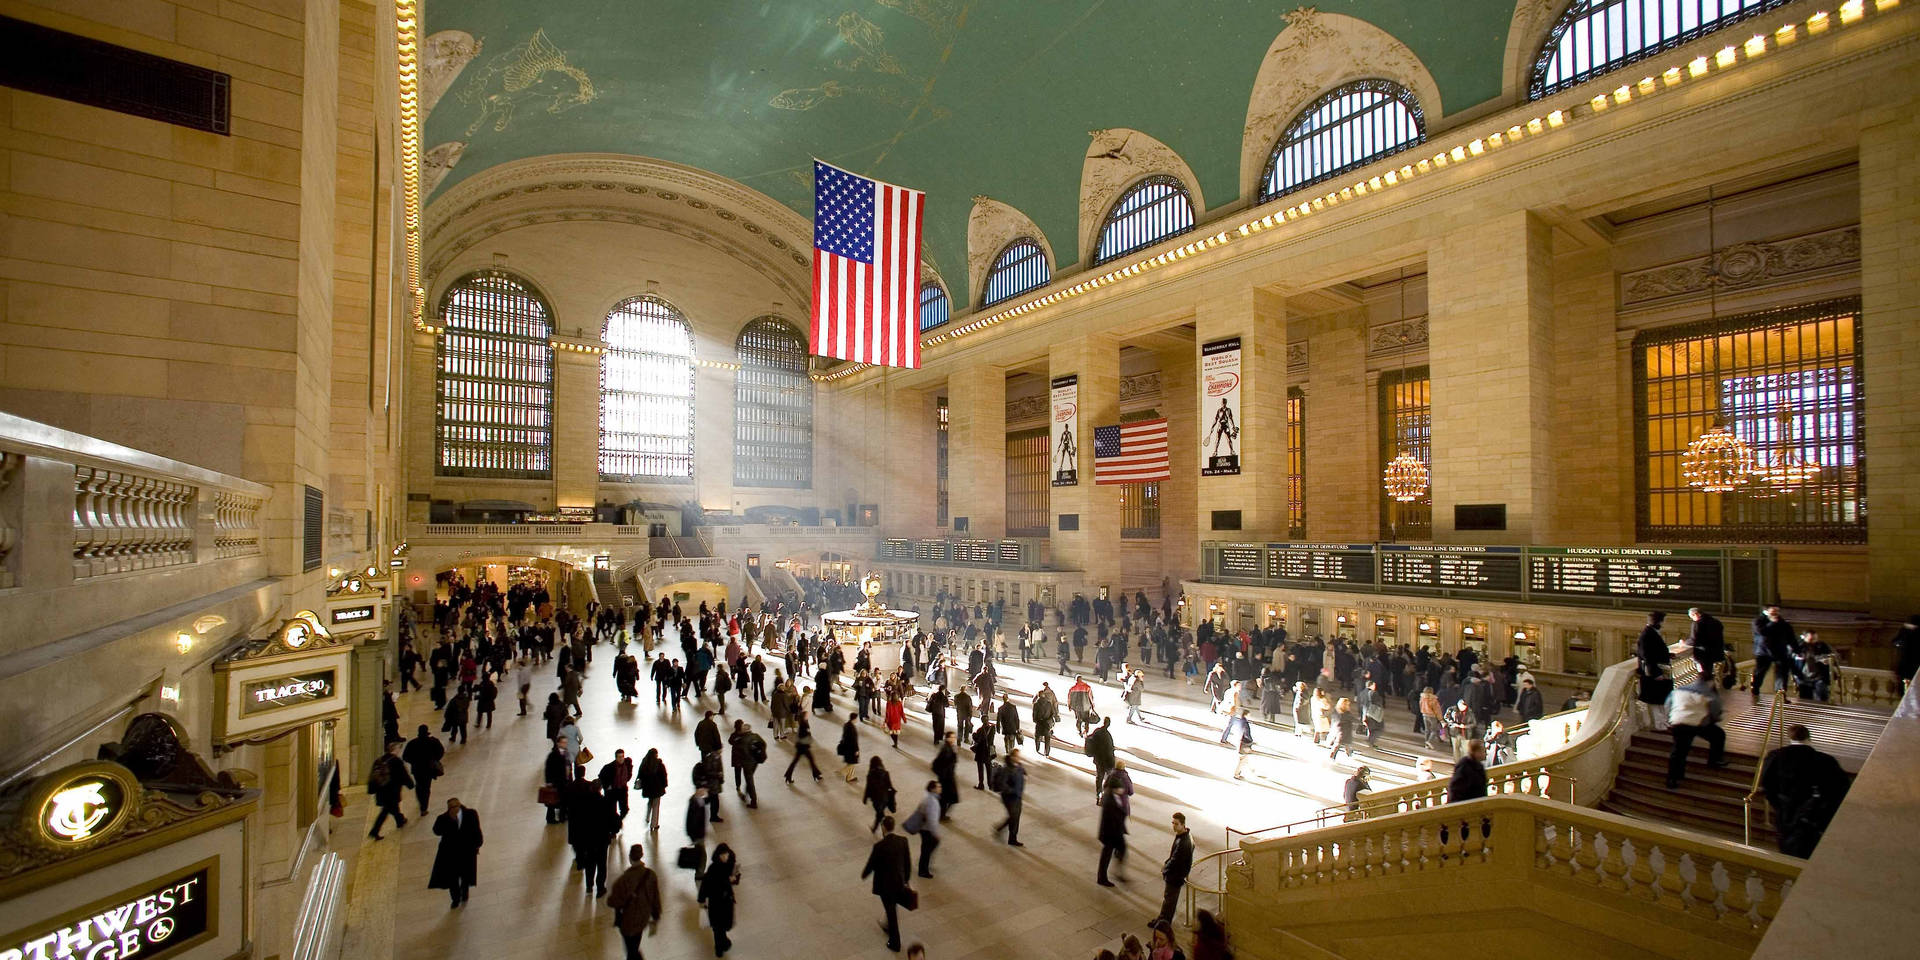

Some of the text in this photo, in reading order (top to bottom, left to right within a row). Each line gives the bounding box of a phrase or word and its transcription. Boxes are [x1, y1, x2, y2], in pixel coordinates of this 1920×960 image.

[1371, 602, 1424, 611] METRO-NORTH
[336, 611, 361, 620] TRACK
[256, 679, 325, 702] TRACK 30
